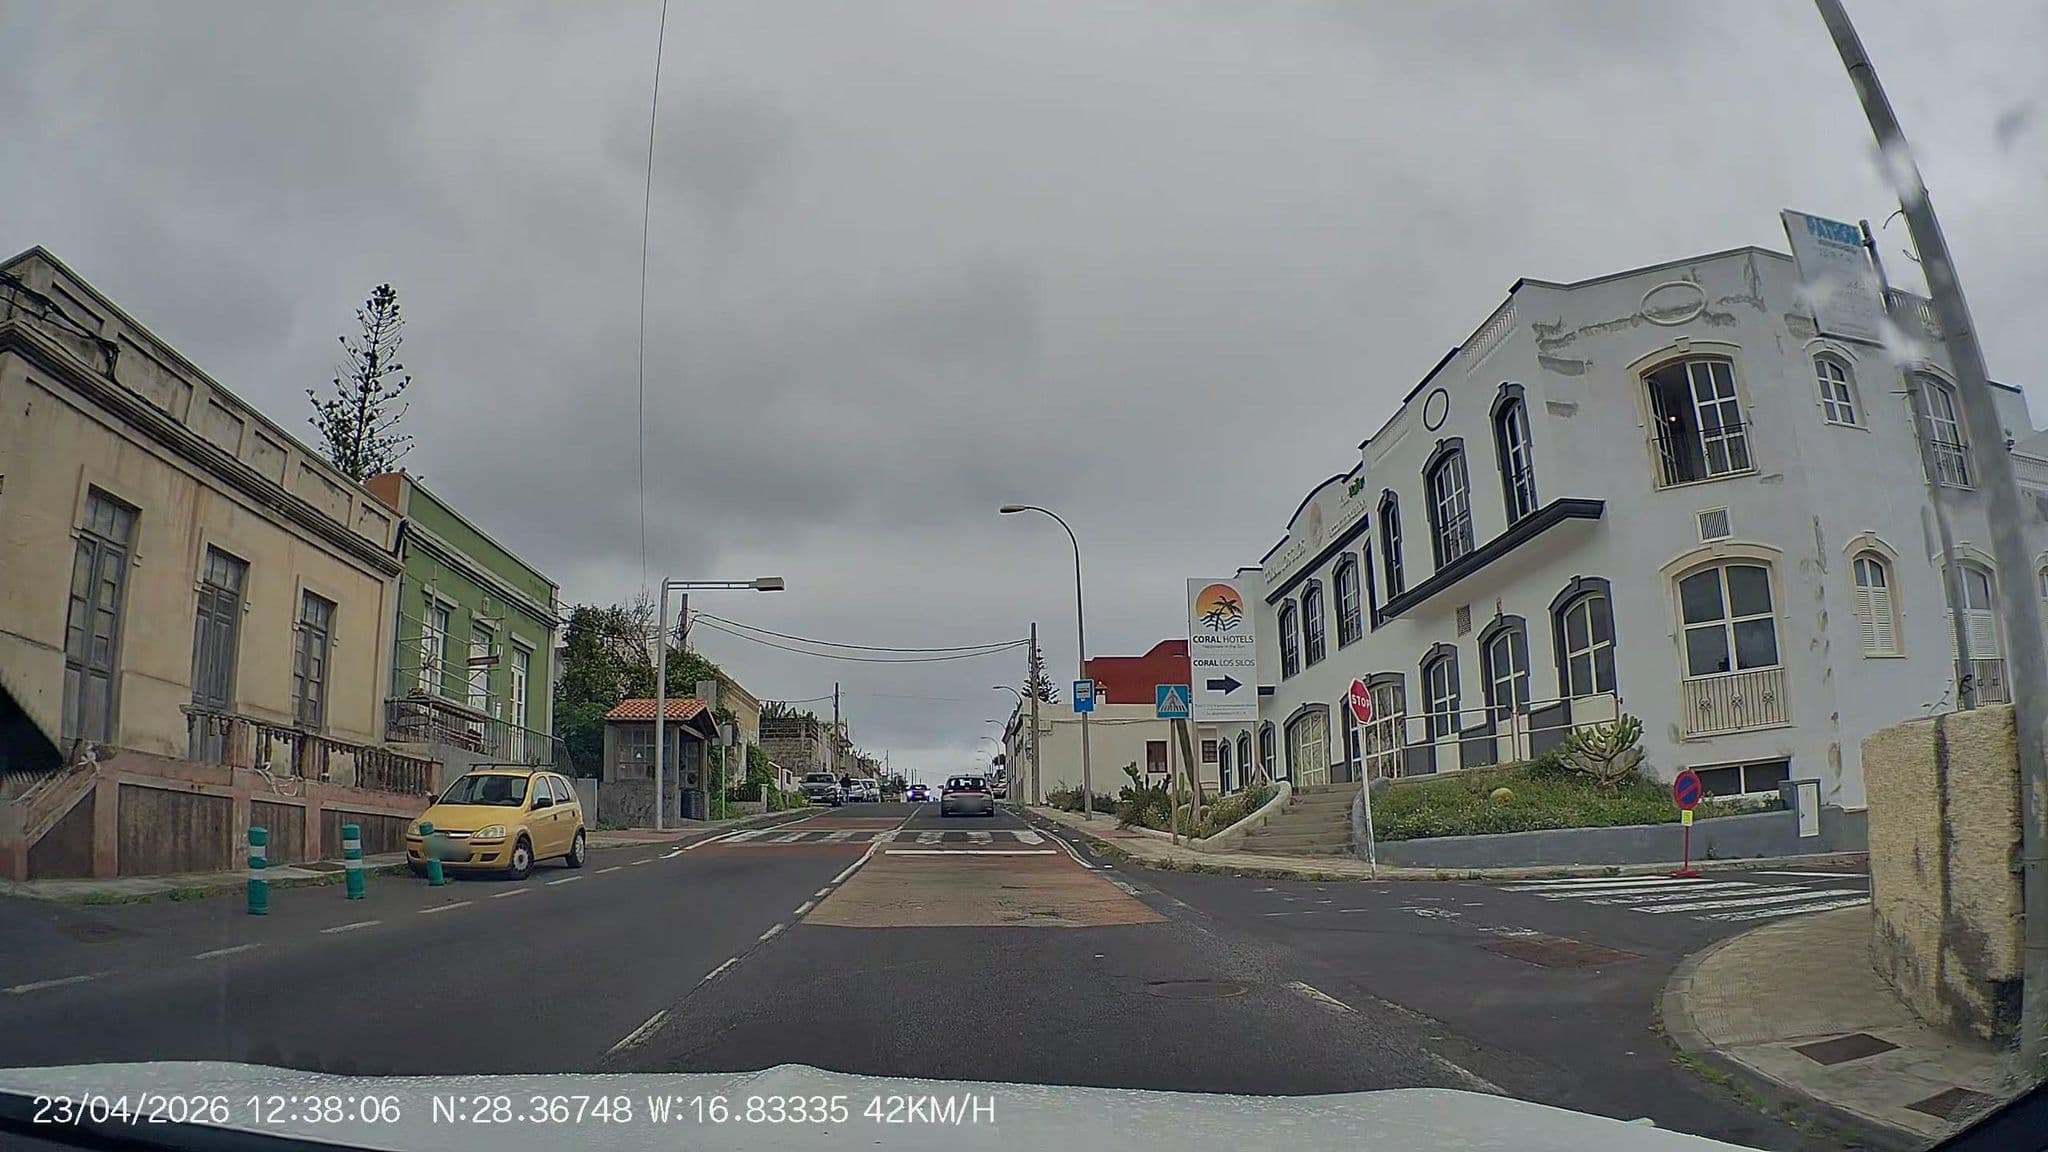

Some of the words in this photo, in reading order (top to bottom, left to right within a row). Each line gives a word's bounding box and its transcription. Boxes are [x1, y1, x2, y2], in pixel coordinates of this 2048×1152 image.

[1193, 635, 1221, 644] CORAL
[1223, 635, 1254, 644] HOTELS
[1193, 659, 1218, 667] CORAL
[1220, 659, 1234, 667] LOS
[1235, 659, 1255, 667] SILOS
[1351, 694, 1370, 709] STOP
